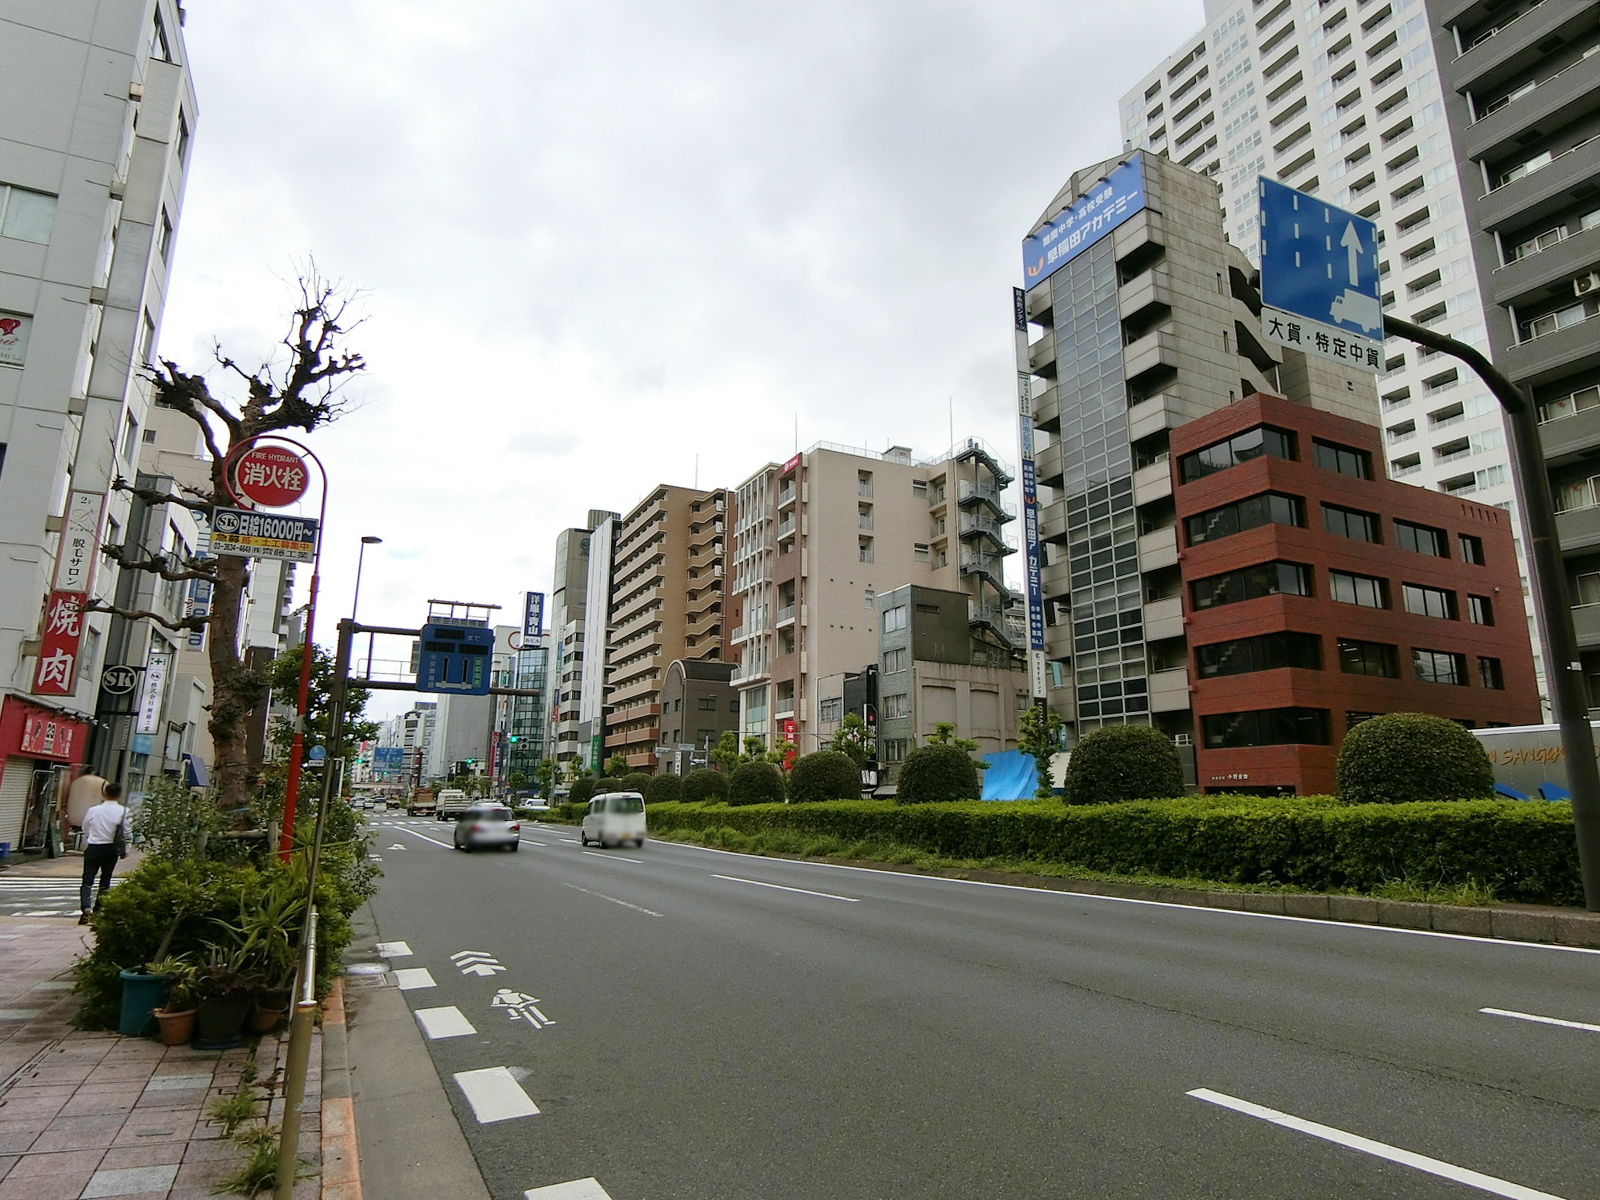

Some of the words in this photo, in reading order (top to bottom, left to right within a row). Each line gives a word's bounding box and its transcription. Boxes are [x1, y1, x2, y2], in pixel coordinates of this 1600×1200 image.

[1047, 190, 1138, 265] 早稲田アカデミー
[1268, 317, 1380, 369] 大貨・特定中貨
[243, 461, 304, 491] 消火栓
[251, 452, 267, 460] FIRE
[268, 453, 299, 464] HYDRANT
[66, 538, 86, 586] 脱毛サロン
[38, 595, 80, 692] 焼肉
[104, 671, 134, 687] SK
